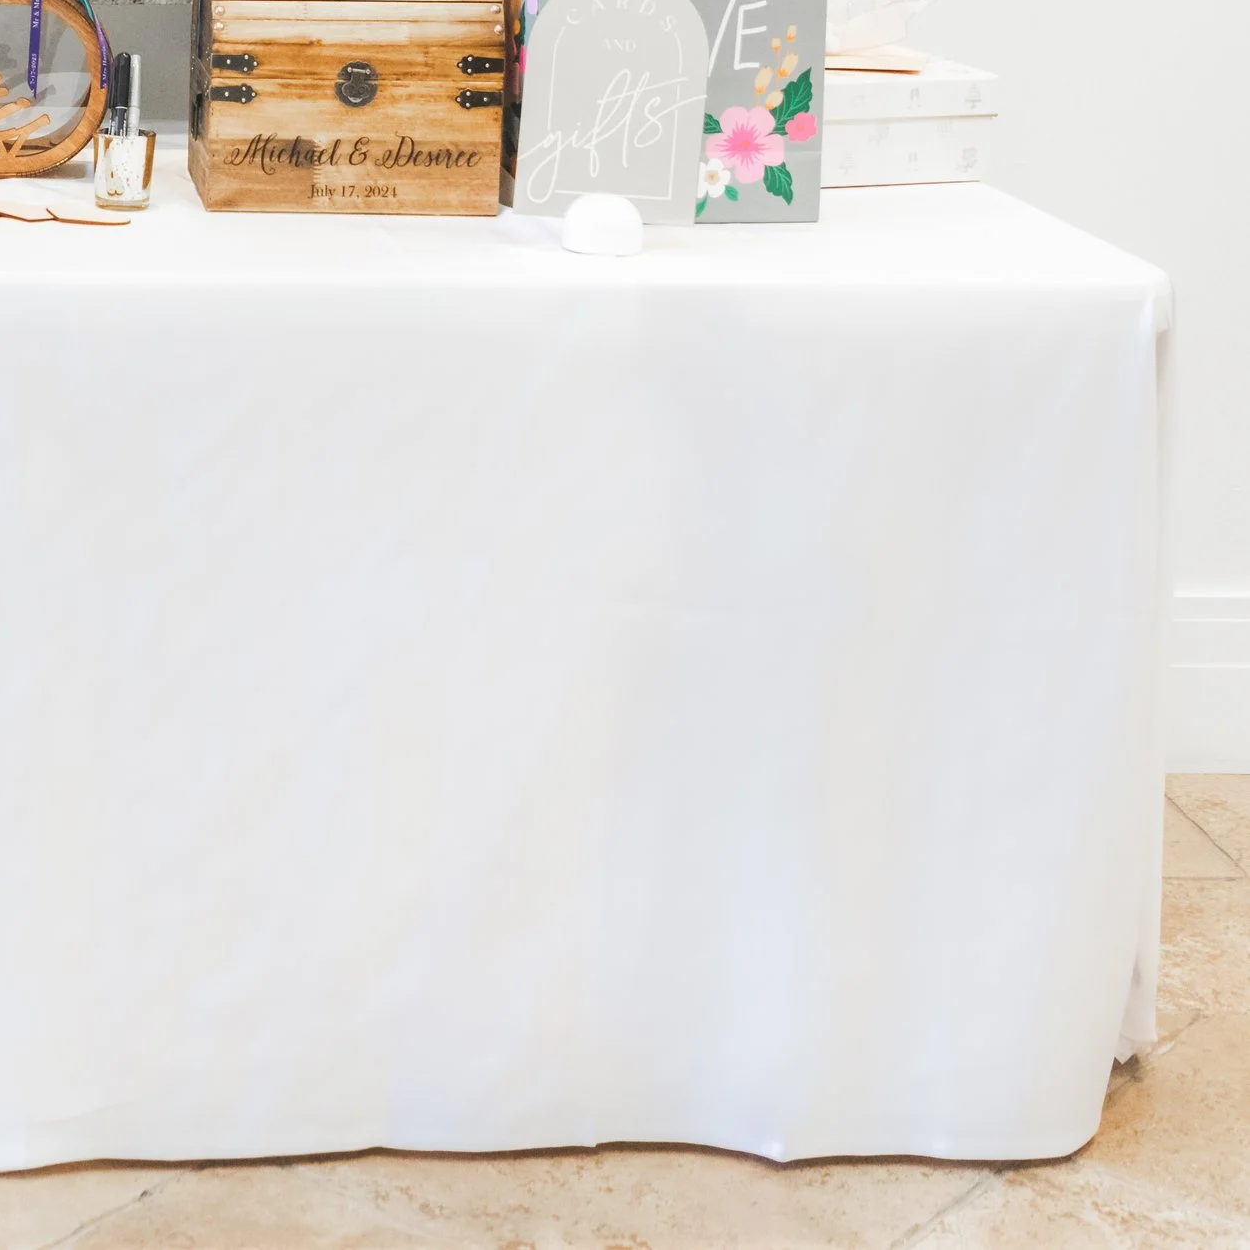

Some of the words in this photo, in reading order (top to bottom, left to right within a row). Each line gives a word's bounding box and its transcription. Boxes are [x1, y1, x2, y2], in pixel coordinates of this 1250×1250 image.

[32, 18, 40, 29] Mr
[602, 37, 638, 53] AND
[516, 69, 708, 204] gifts
[224, 133, 342, 176] Michael
[348, 136, 369, 167] &
[375, 131, 484, 169] Desiree
[307, 184, 337, 201] July
[341, 185, 361, 201] 17,
